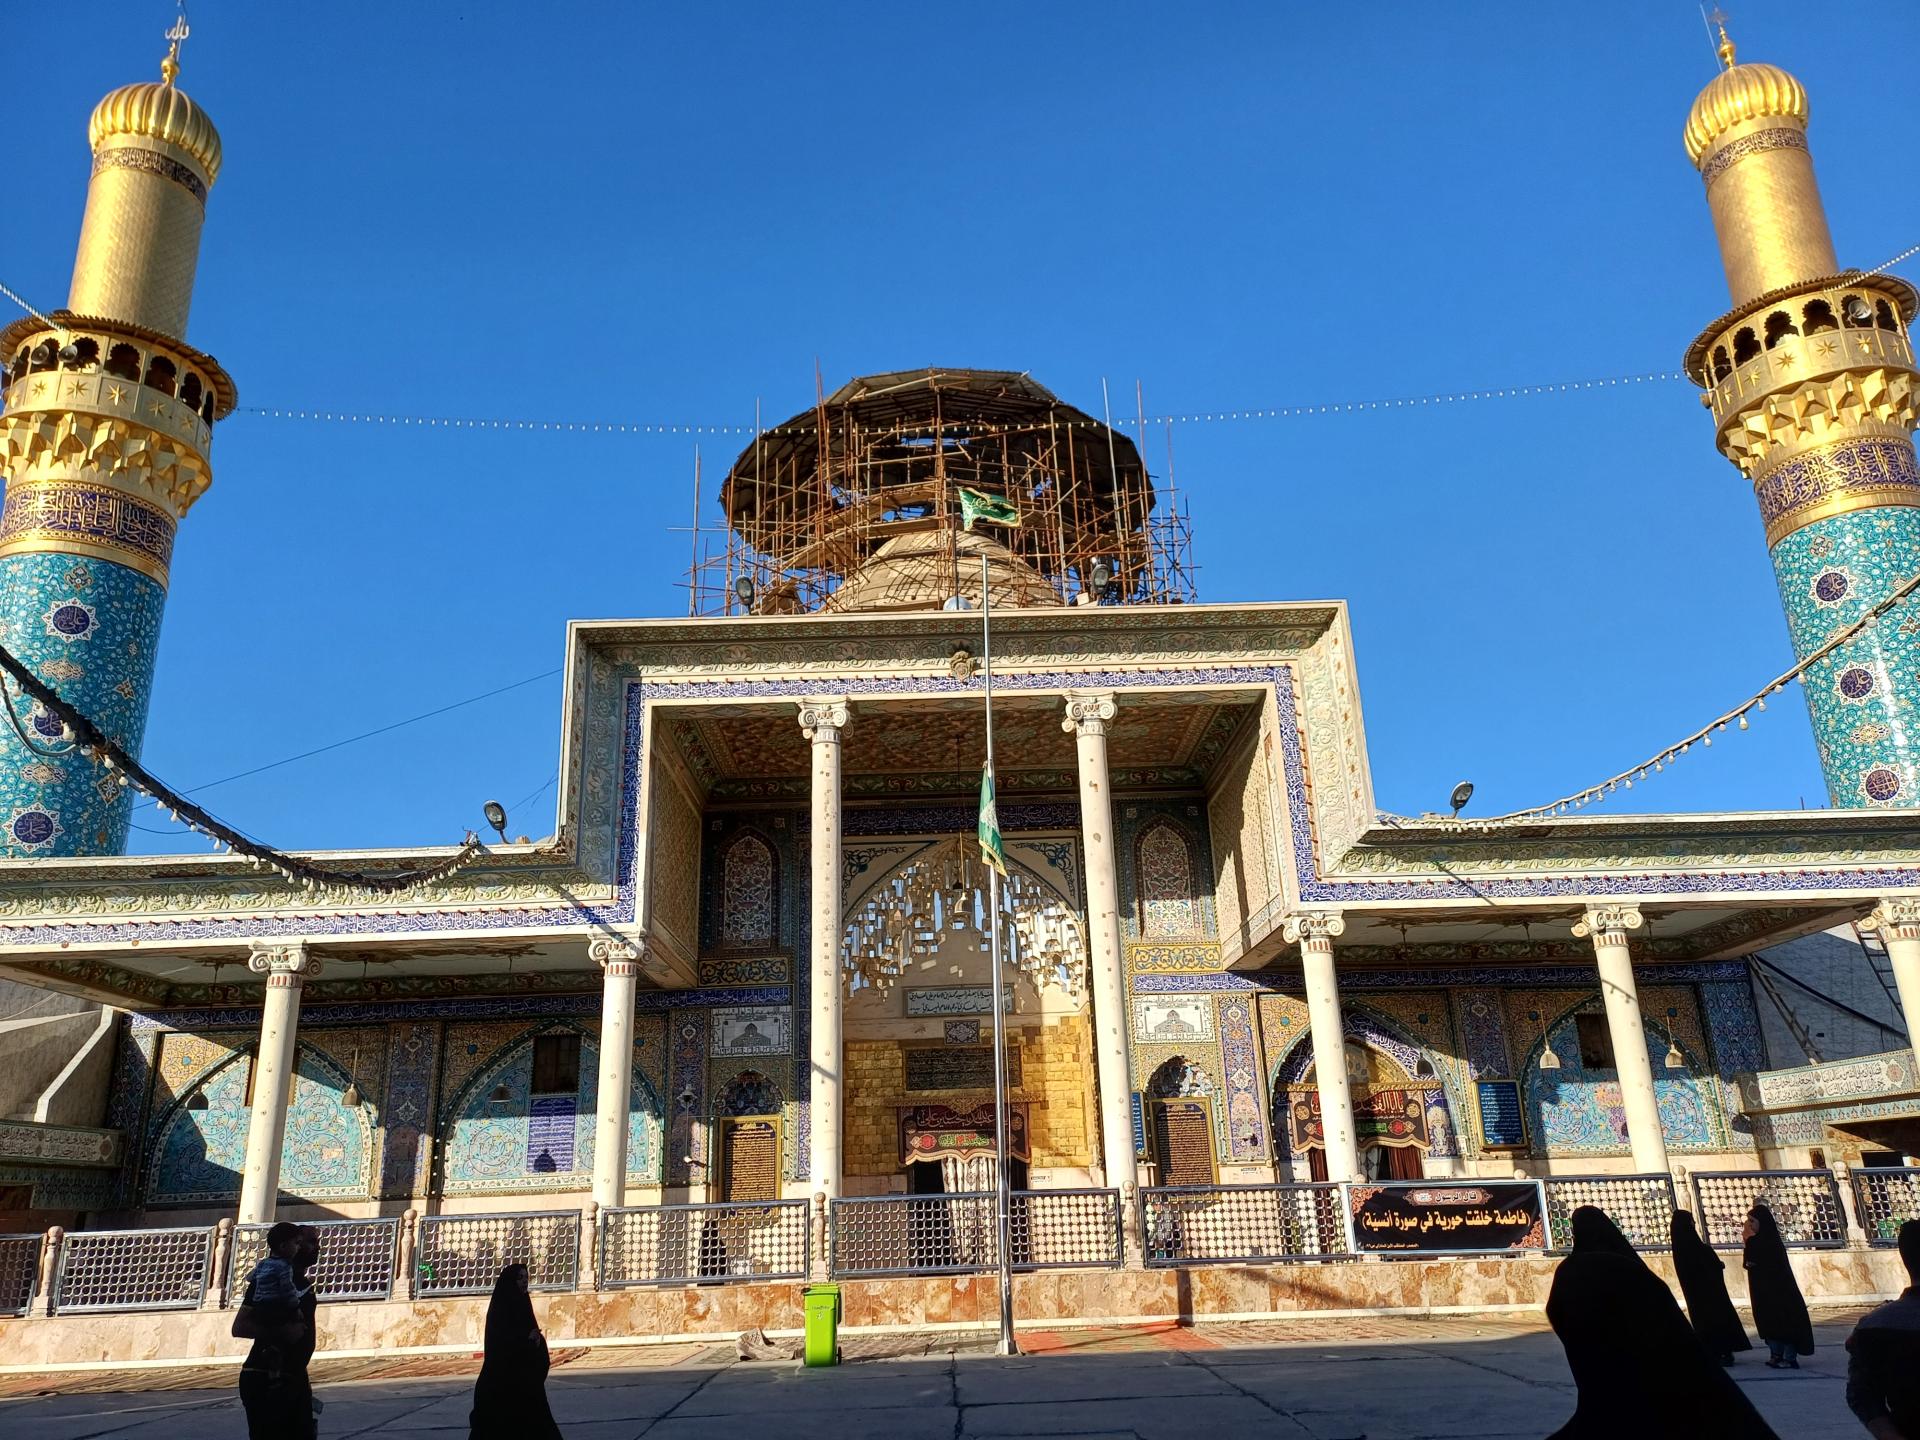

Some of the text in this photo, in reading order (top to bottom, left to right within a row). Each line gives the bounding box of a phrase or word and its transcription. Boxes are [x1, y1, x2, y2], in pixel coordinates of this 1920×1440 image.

[1435, 1190, 1462, 1203] الرسول
[1463, 1190, 1478, 1202] قال
[1394, 1211, 1418, 1231] صورة
[1420, 1211, 1434, 1233] في
[1434, 1211, 1464, 1231] حورية
[1465, 1209, 1493, 1226] خلقت
